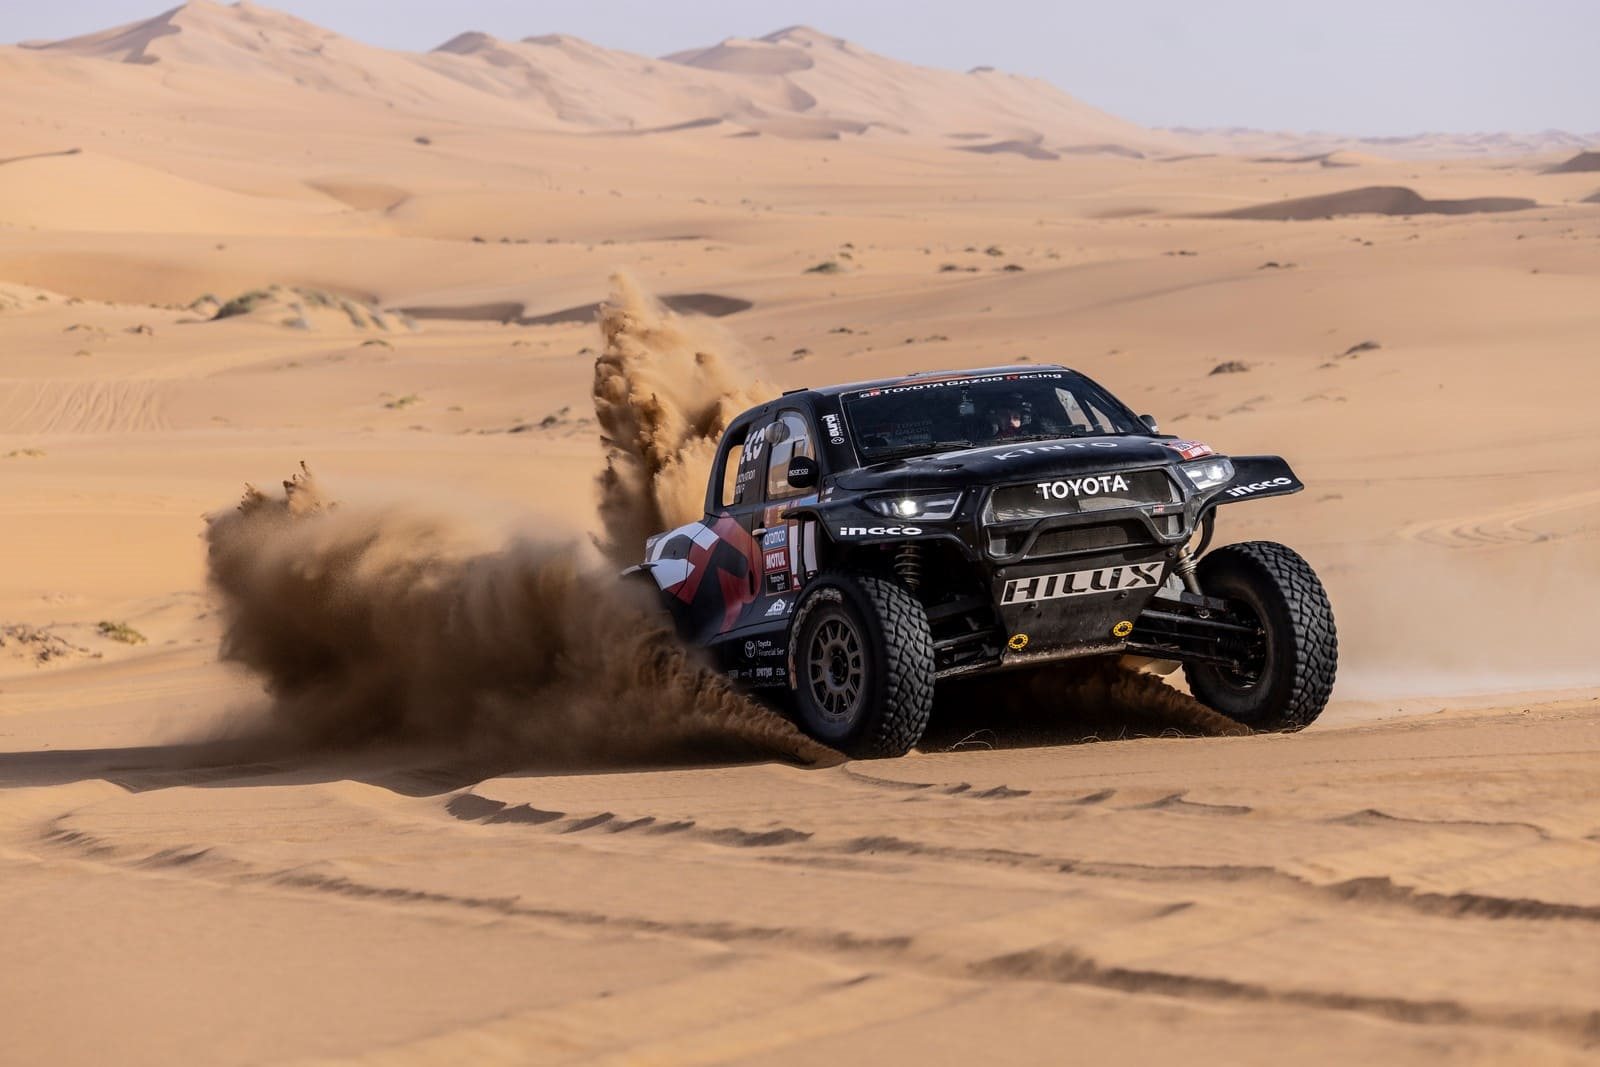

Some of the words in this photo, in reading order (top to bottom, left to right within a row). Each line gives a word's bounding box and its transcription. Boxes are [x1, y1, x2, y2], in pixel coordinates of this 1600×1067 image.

[881, 382, 944, 394] TOYOTA
[946, 377, 1003, 386] GAZOO
[992, 442, 1118, 461] KINTO
[1037, 475, 1129, 500] TOYOTA
[764, 530, 786, 546] aramco
[766, 551, 786, 570] MOTUL
[1003, 563, 1161, 603] HILUX
